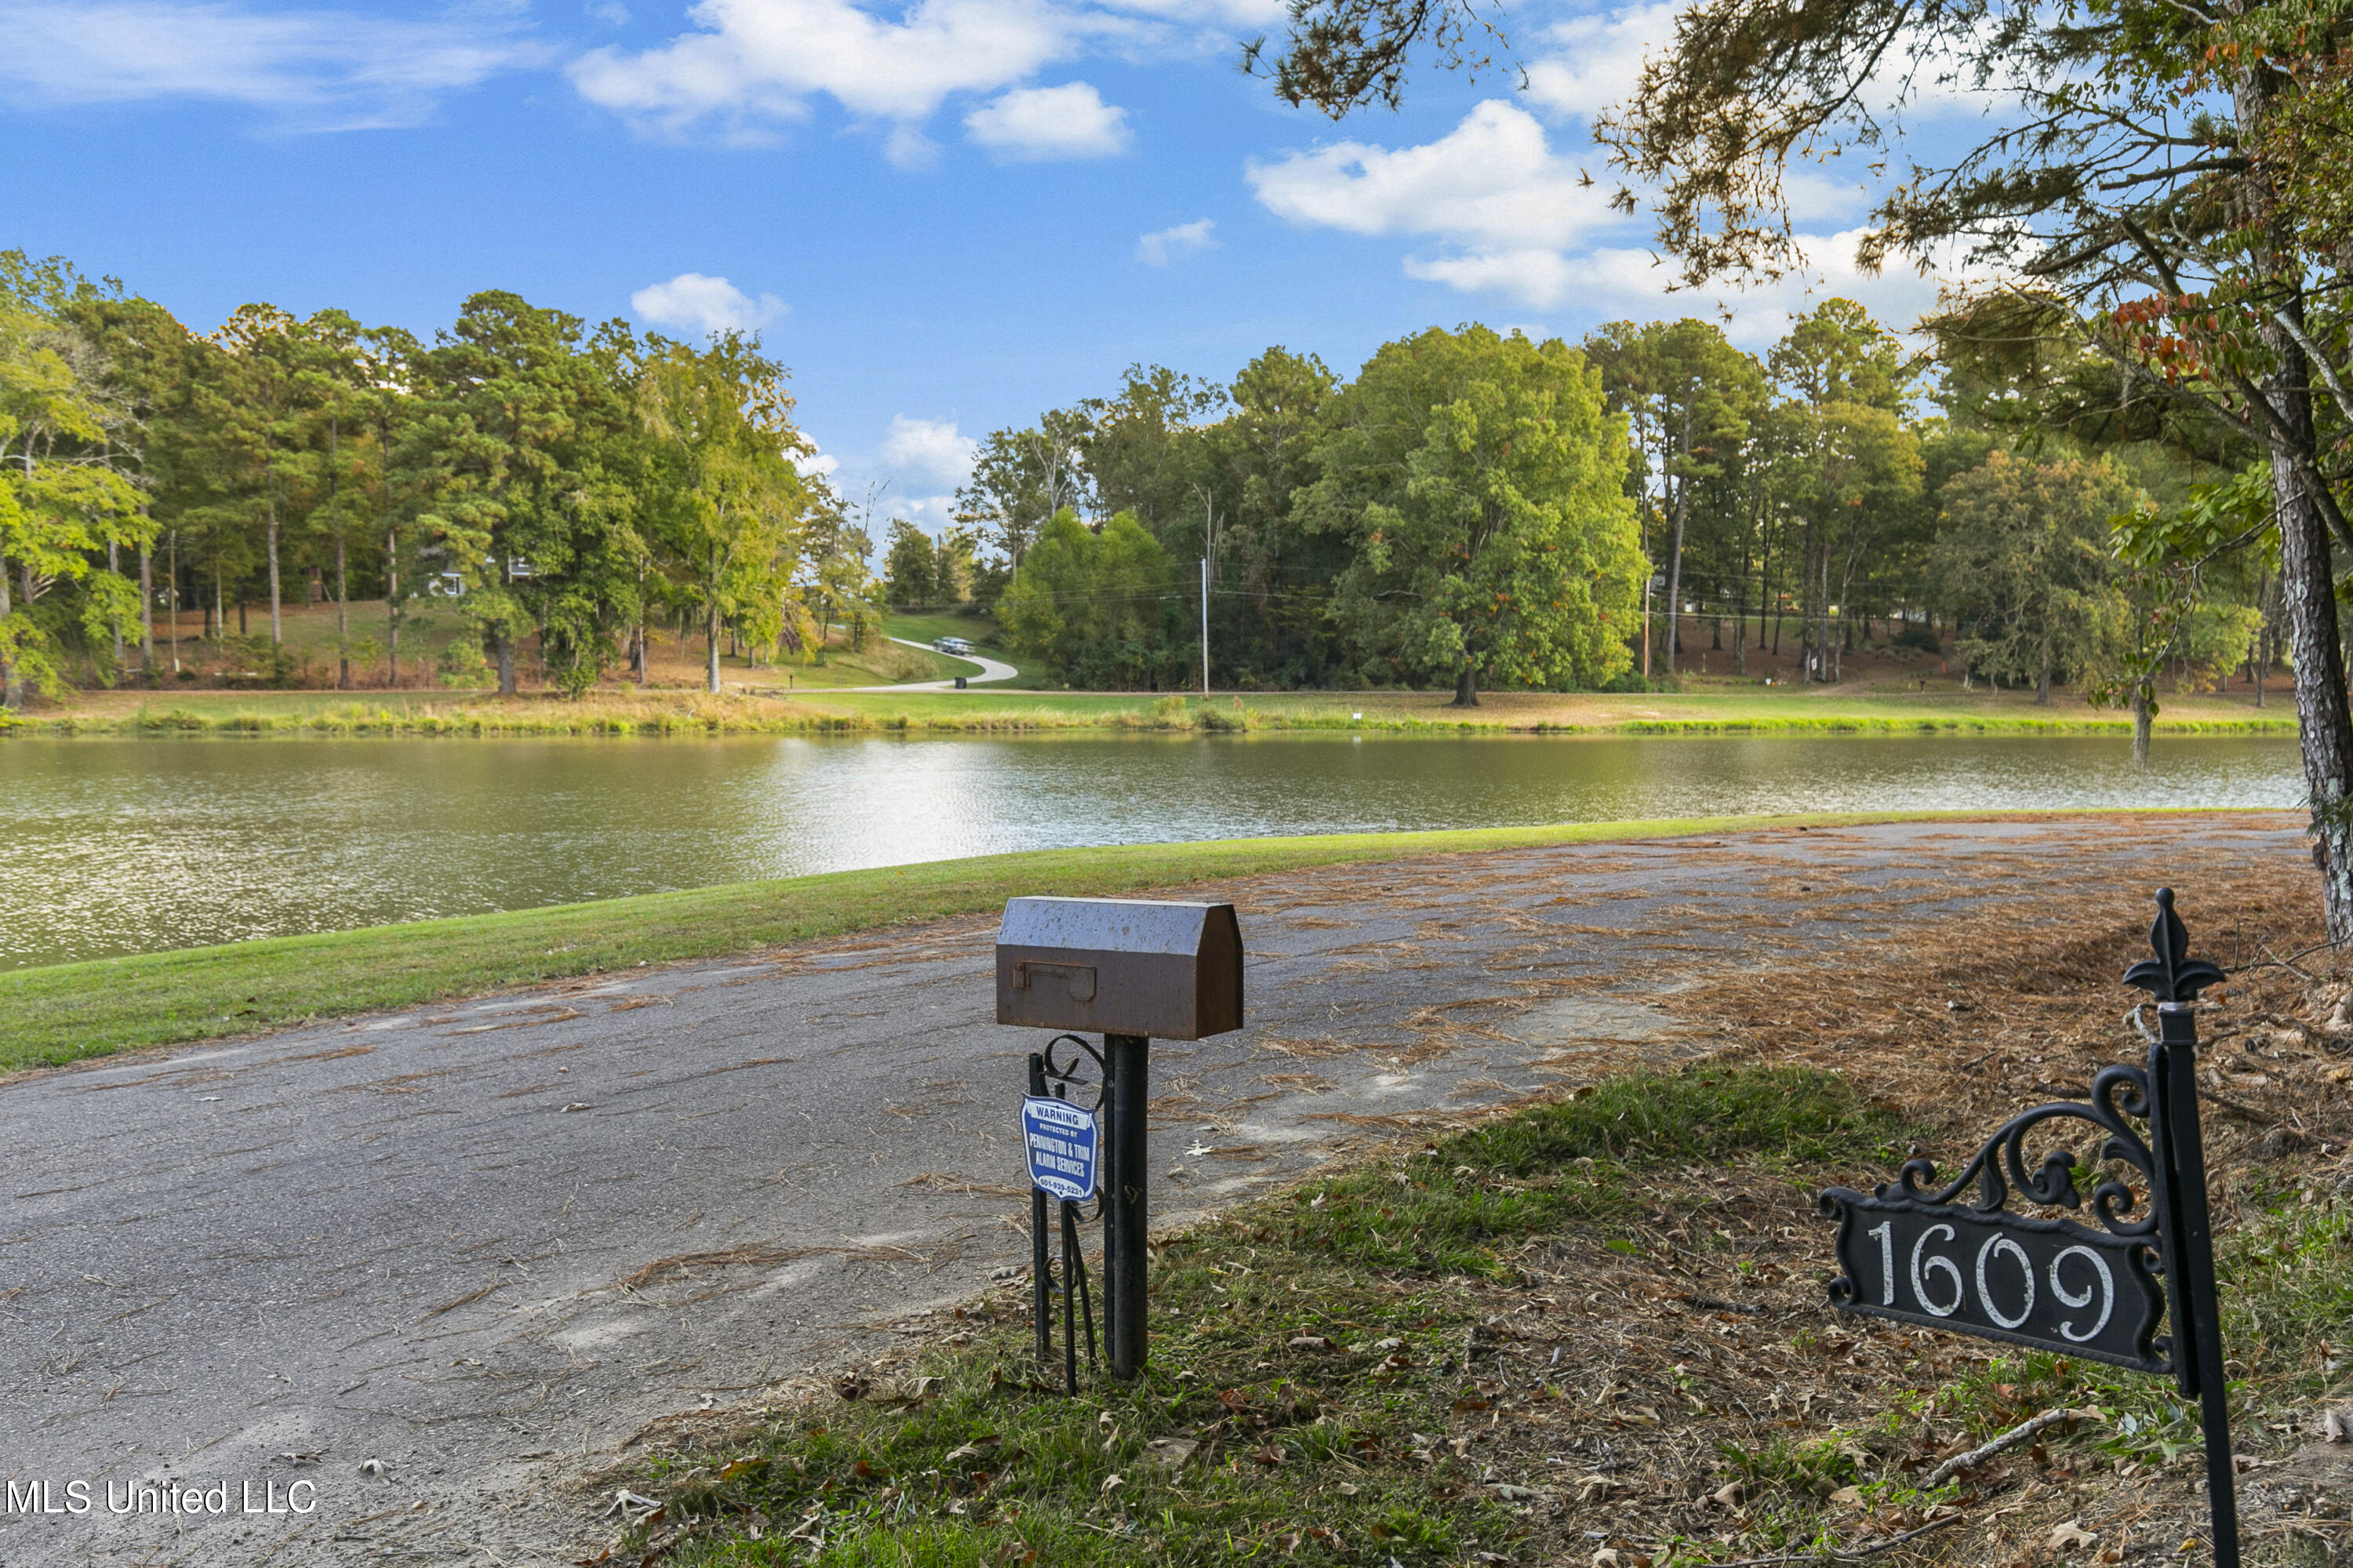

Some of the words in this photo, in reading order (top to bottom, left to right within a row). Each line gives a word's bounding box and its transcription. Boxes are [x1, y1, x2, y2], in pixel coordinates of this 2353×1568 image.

[1036, 1105, 1078, 1125] WARNING
[1039, 1123, 1069, 1136] PROTECTED
[1029, 1133, 1067, 1155] PENNINGTON
[1068, 1142, 1073, 1158] &
[1074, 1144, 1090, 1161] TRIM
[1035, 1151, 1056, 1170] ALARM
[1056, 1157, 1084, 1177] SERVICES
[1040, 1178, 1082, 1196] 601-939-5231
[1867, 1221, 2115, 1342] 1609
